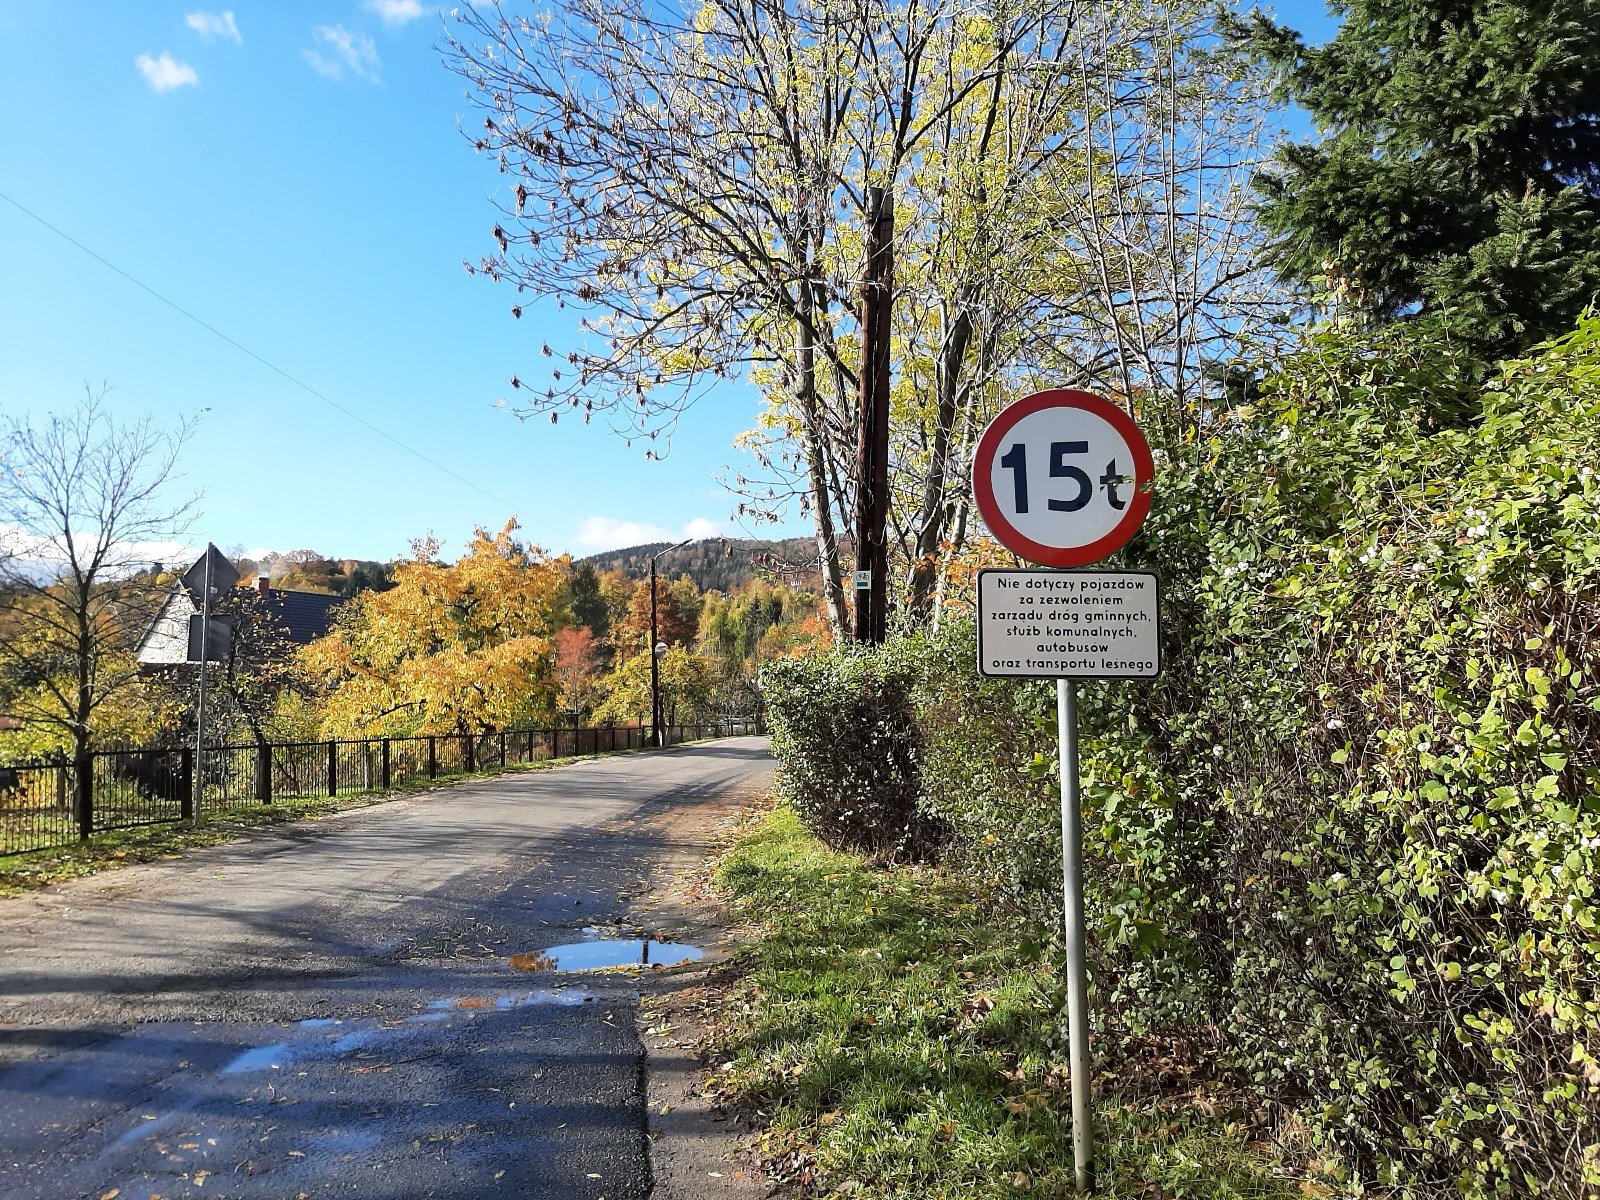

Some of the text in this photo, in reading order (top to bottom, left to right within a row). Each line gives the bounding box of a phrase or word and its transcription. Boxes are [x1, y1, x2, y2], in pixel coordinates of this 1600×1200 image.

[998, 578, 1144, 591] Nie dotyczy pojazdów
[1019, 593, 1124, 605] za zezwoleniem
[992, 609, 1151, 623] zarządu dróg gminnych,
[1007, 625, 1137, 639] służb komunalnych,
[1037, 642, 1108, 652] autobusów
[992, 658, 1152, 672] oraz transportu leśnego
